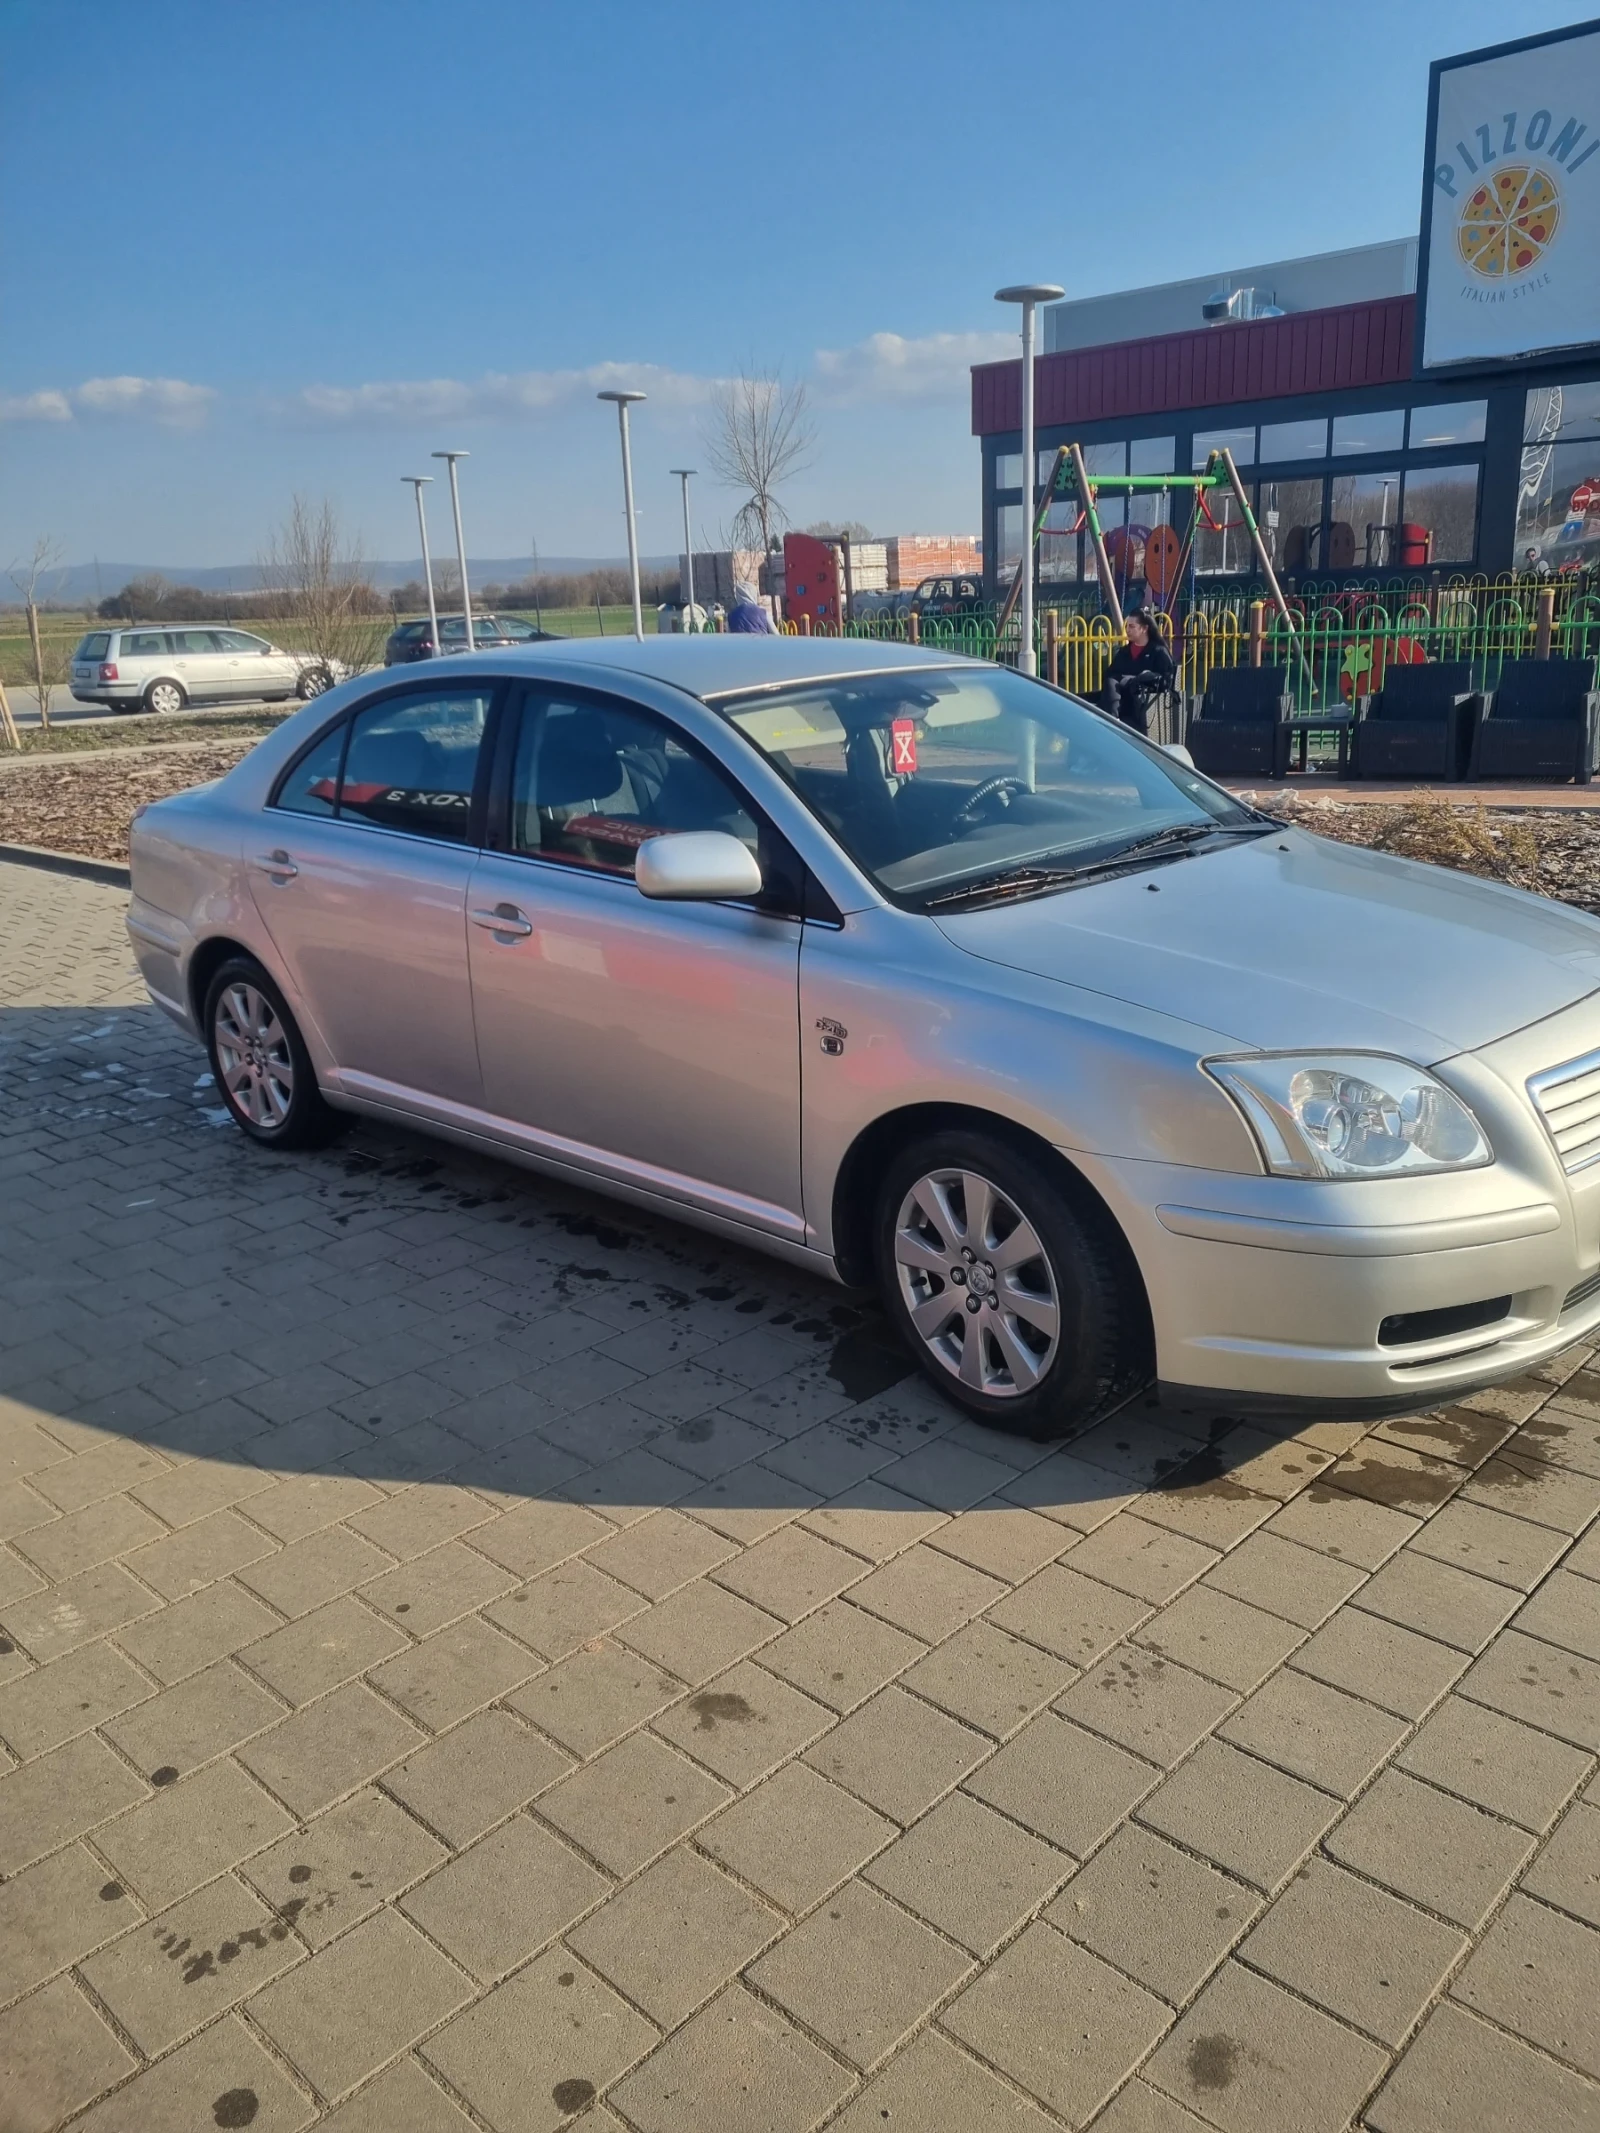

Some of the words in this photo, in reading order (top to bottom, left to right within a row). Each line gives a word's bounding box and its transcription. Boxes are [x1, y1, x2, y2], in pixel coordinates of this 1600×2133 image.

[1435, 109, 1600, 198] PIZZONI
[1461, 286, 1505, 302] ITALIAN
[1513, 273, 1551, 299] STYLE
